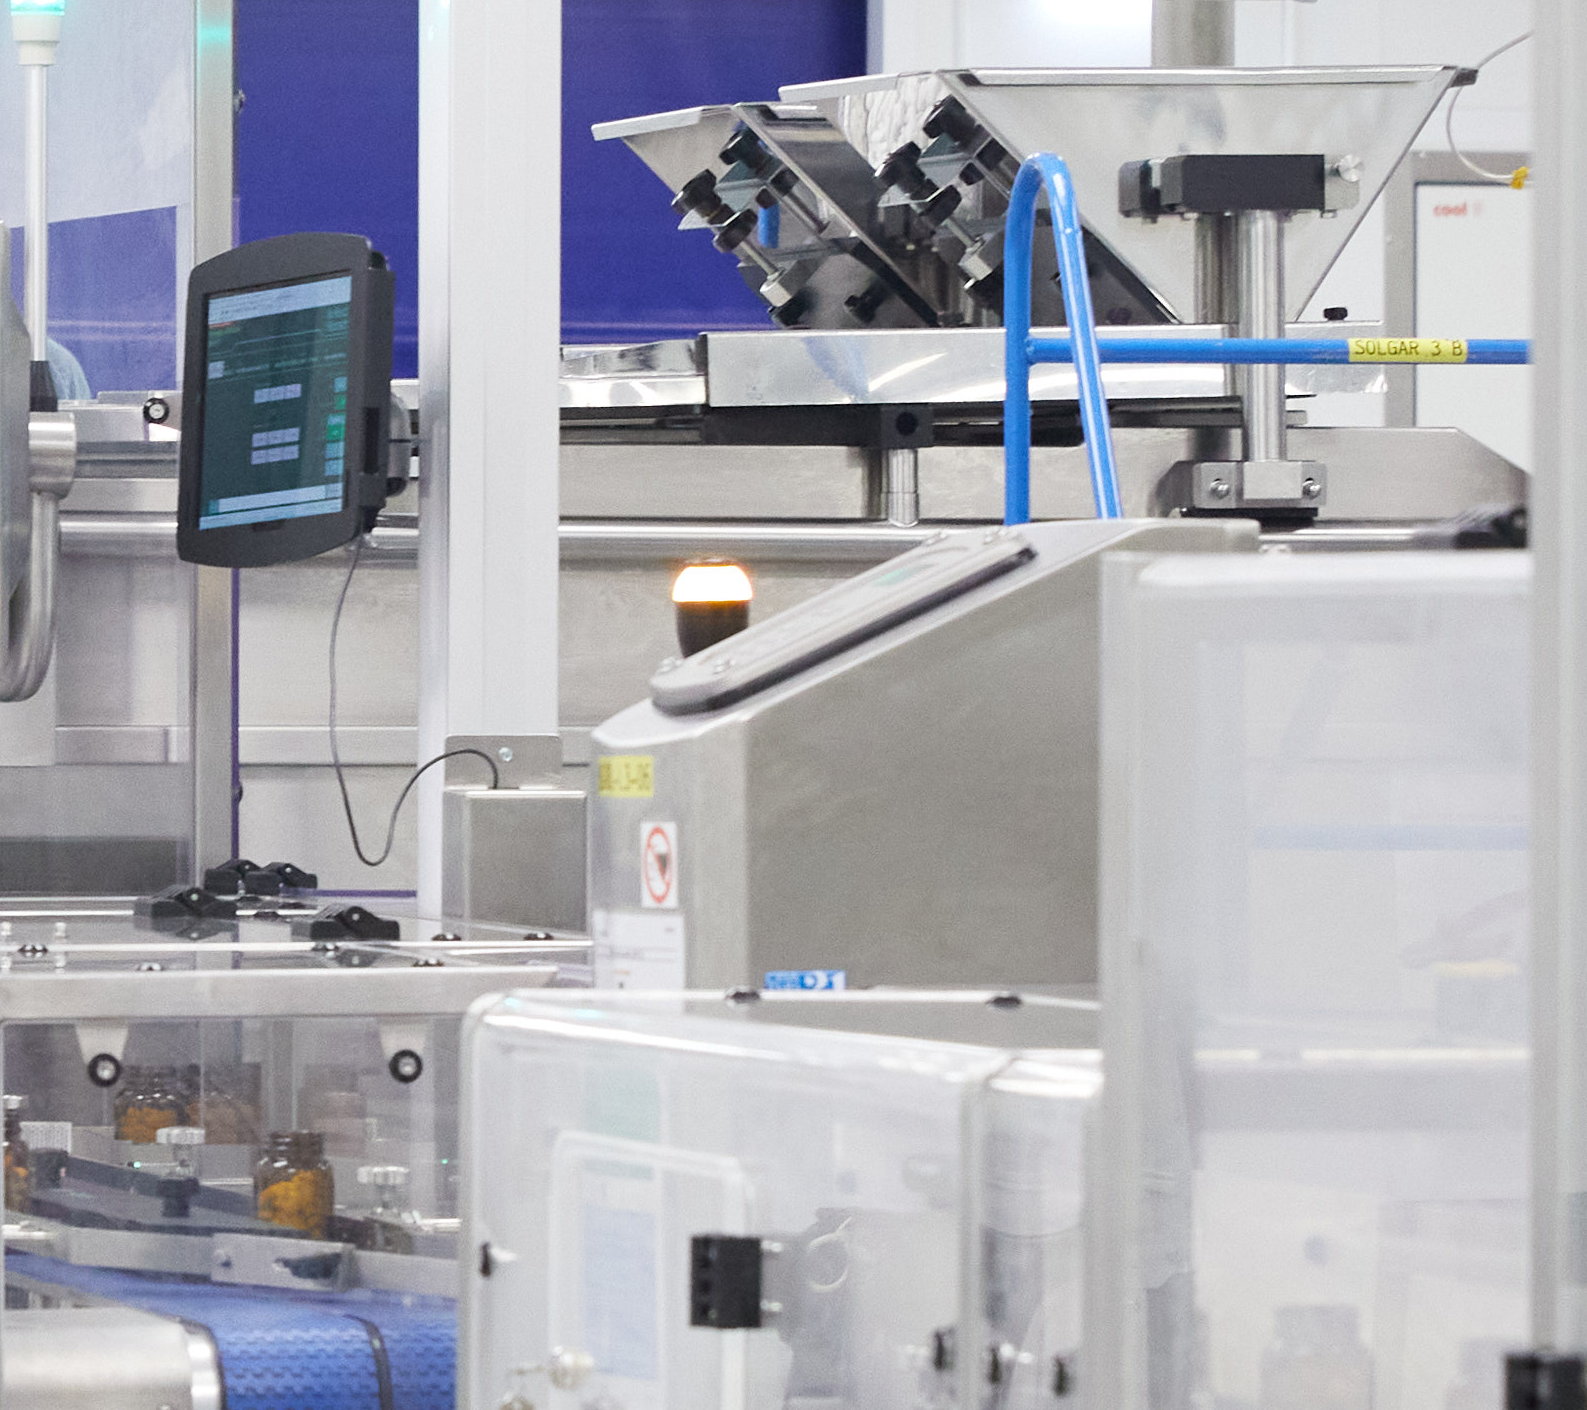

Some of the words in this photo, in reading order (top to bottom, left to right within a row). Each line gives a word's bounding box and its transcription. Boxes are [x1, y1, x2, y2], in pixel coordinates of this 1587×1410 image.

[1353, 339, 1420, 356] SOLGAR
[1431, 339, 1442, 357] 3
[1451, 339, 1463, 357] B
